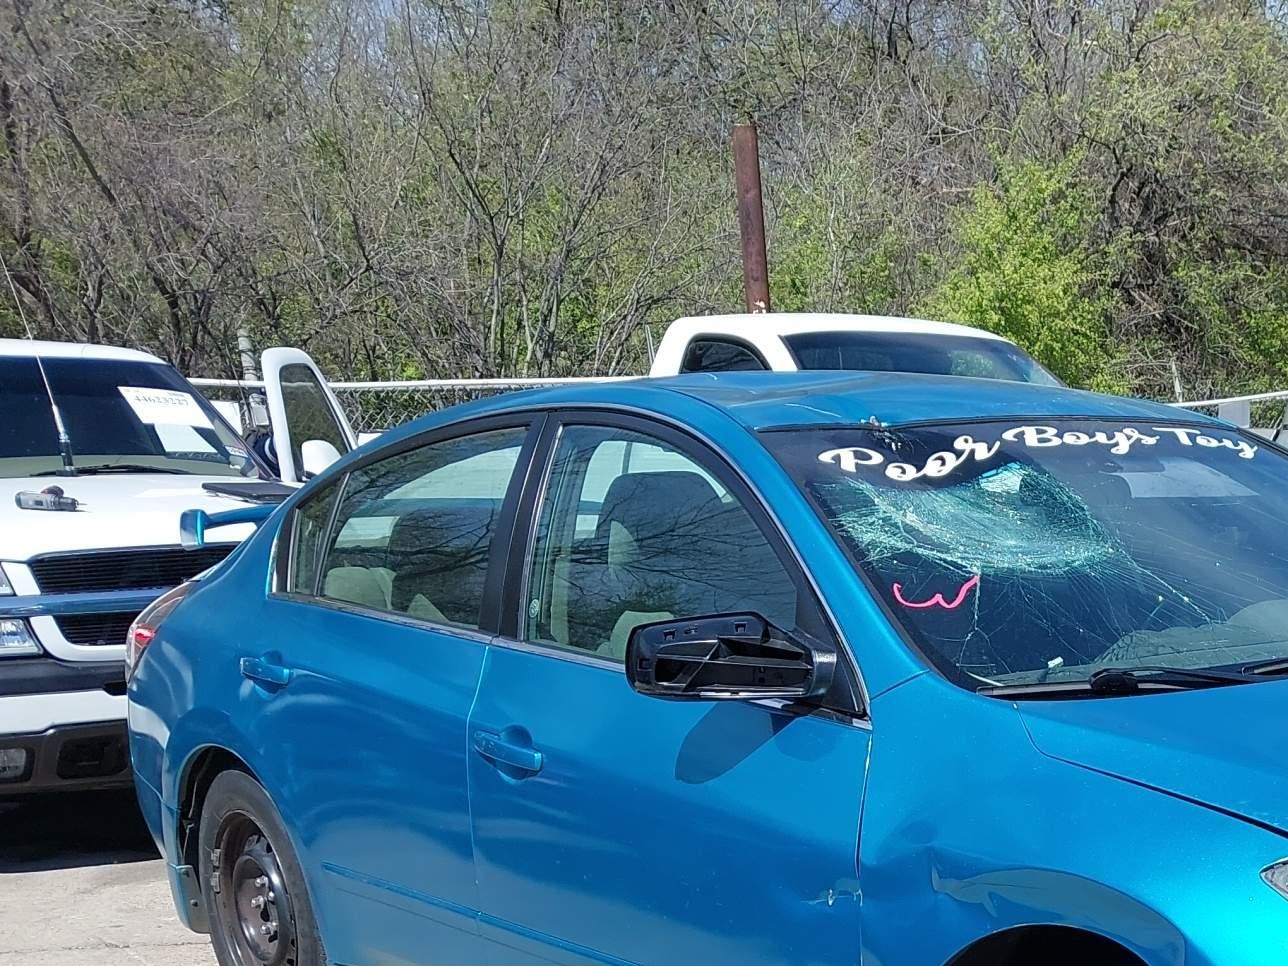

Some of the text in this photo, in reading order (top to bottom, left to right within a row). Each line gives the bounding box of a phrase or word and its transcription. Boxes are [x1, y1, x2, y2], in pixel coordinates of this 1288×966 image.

[818, 425, 1258, 481] Poor Boys Toy
